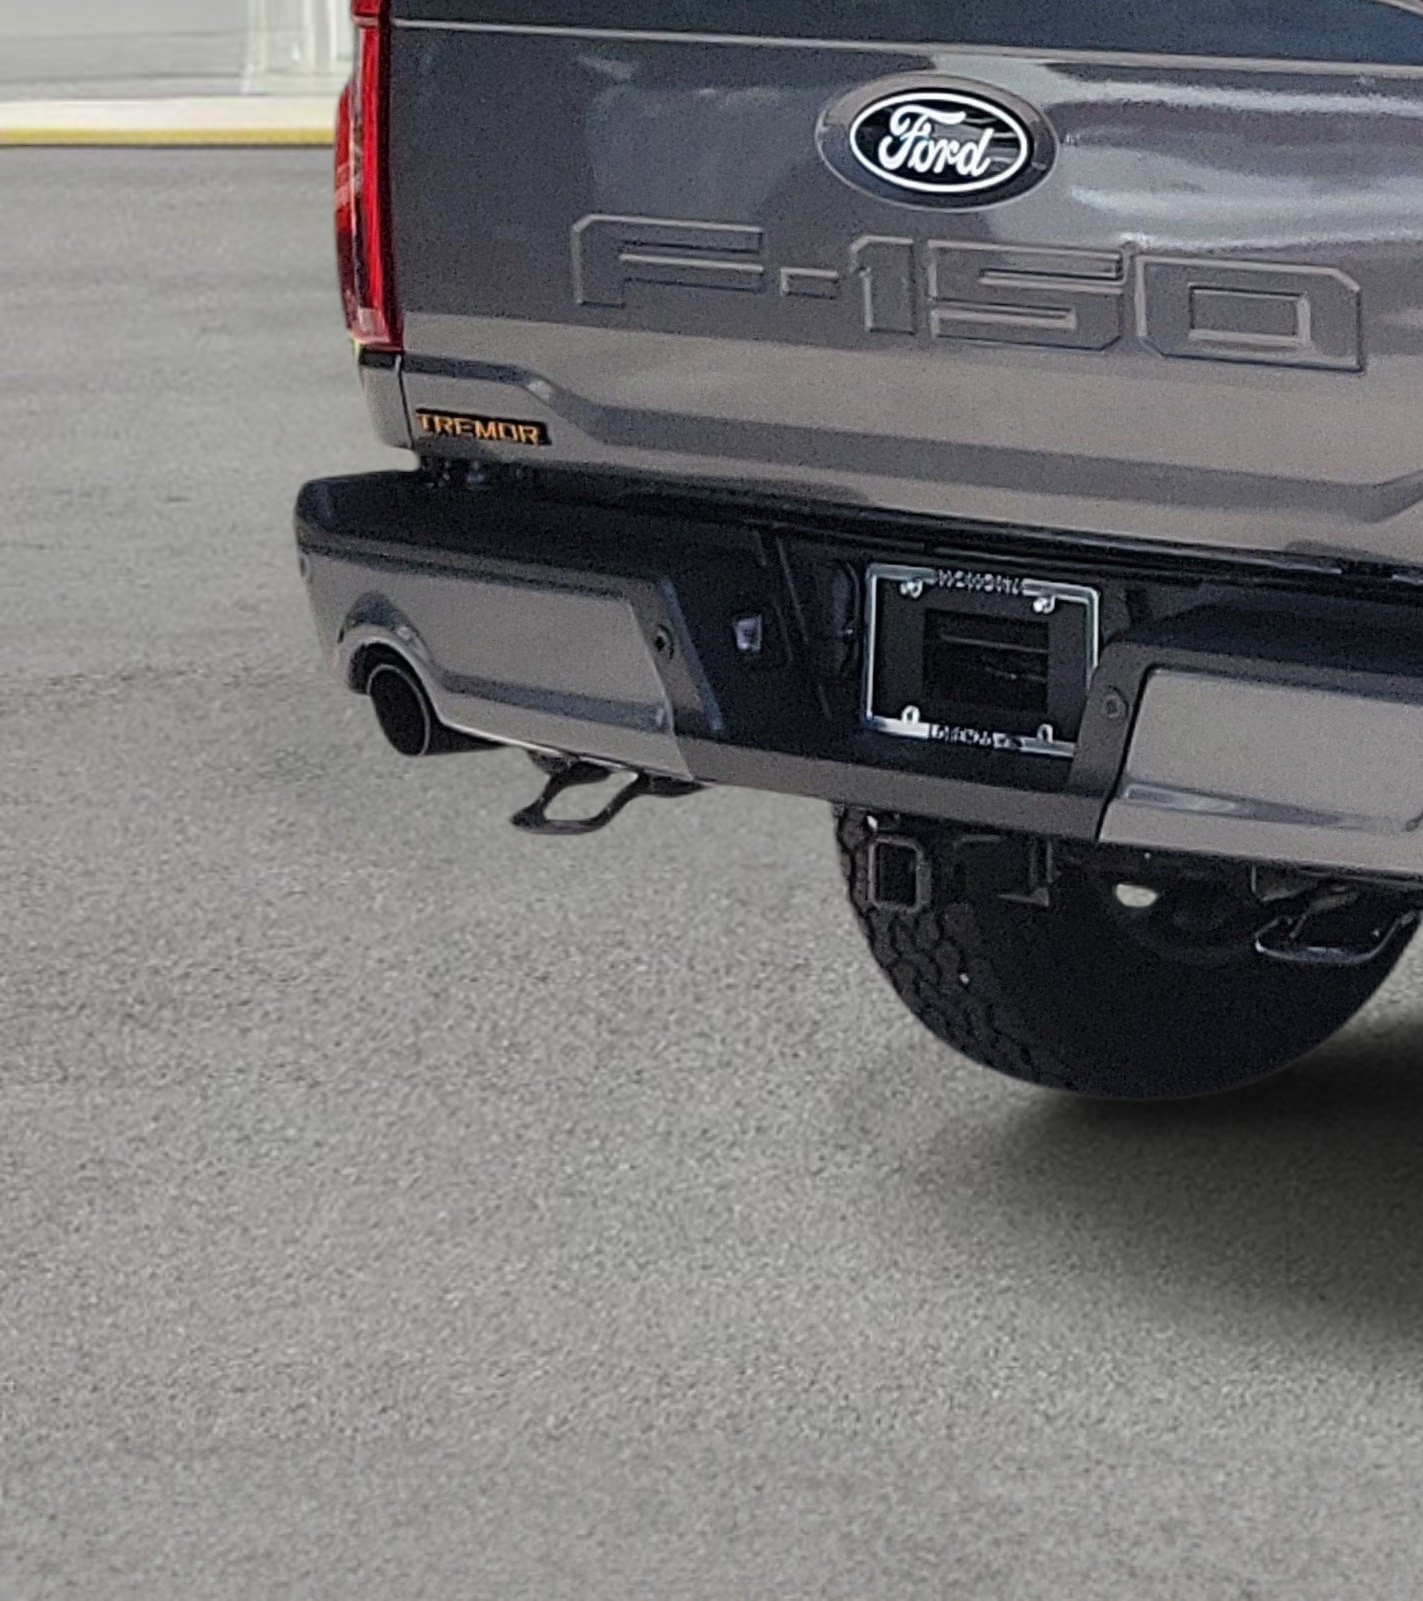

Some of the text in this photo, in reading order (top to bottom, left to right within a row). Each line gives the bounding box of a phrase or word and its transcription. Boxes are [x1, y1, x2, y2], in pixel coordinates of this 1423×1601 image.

[878, 104, 994, 177] Ford
[571, 213, 1365, 373] F-150
[416, 411, 540, 446] TREMOR
